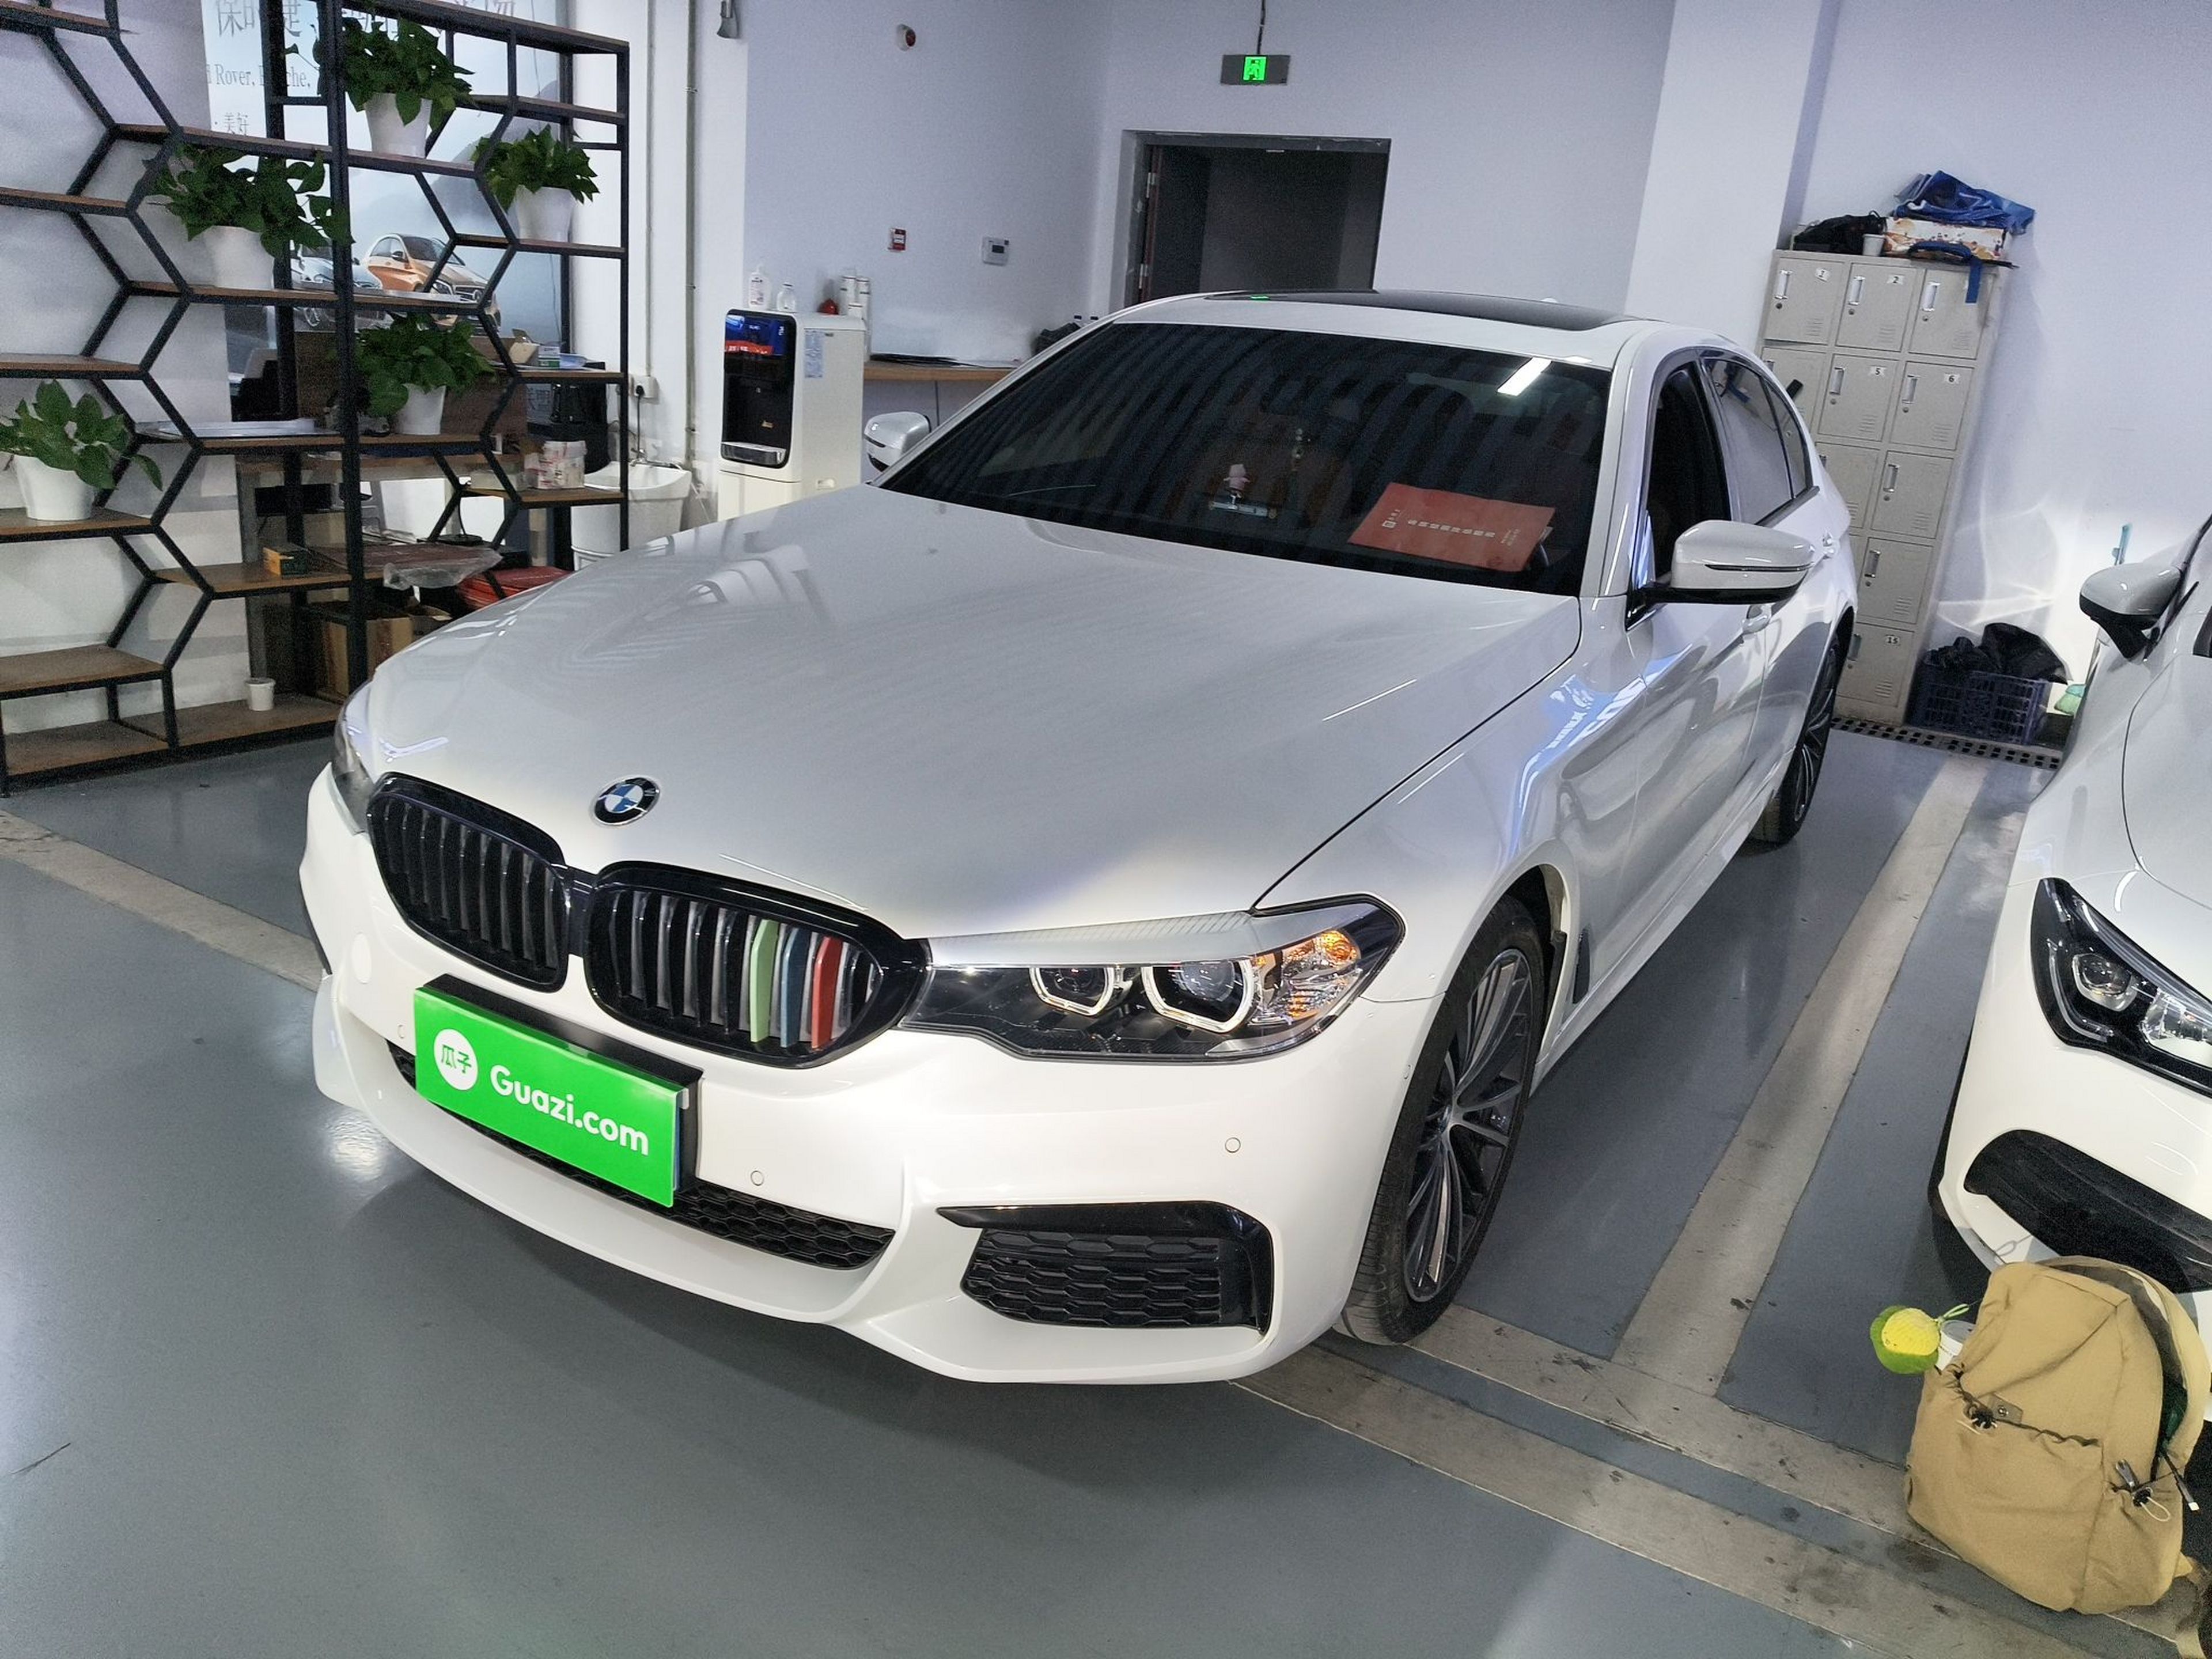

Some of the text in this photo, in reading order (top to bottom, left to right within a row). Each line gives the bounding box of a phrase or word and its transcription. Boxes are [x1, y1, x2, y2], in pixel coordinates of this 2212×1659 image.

[1875, 368, 1881, 376] 5
[441, 1044, 472, 1074] 瓜子
[490, 1065, 649, 1156] Guazi.com
